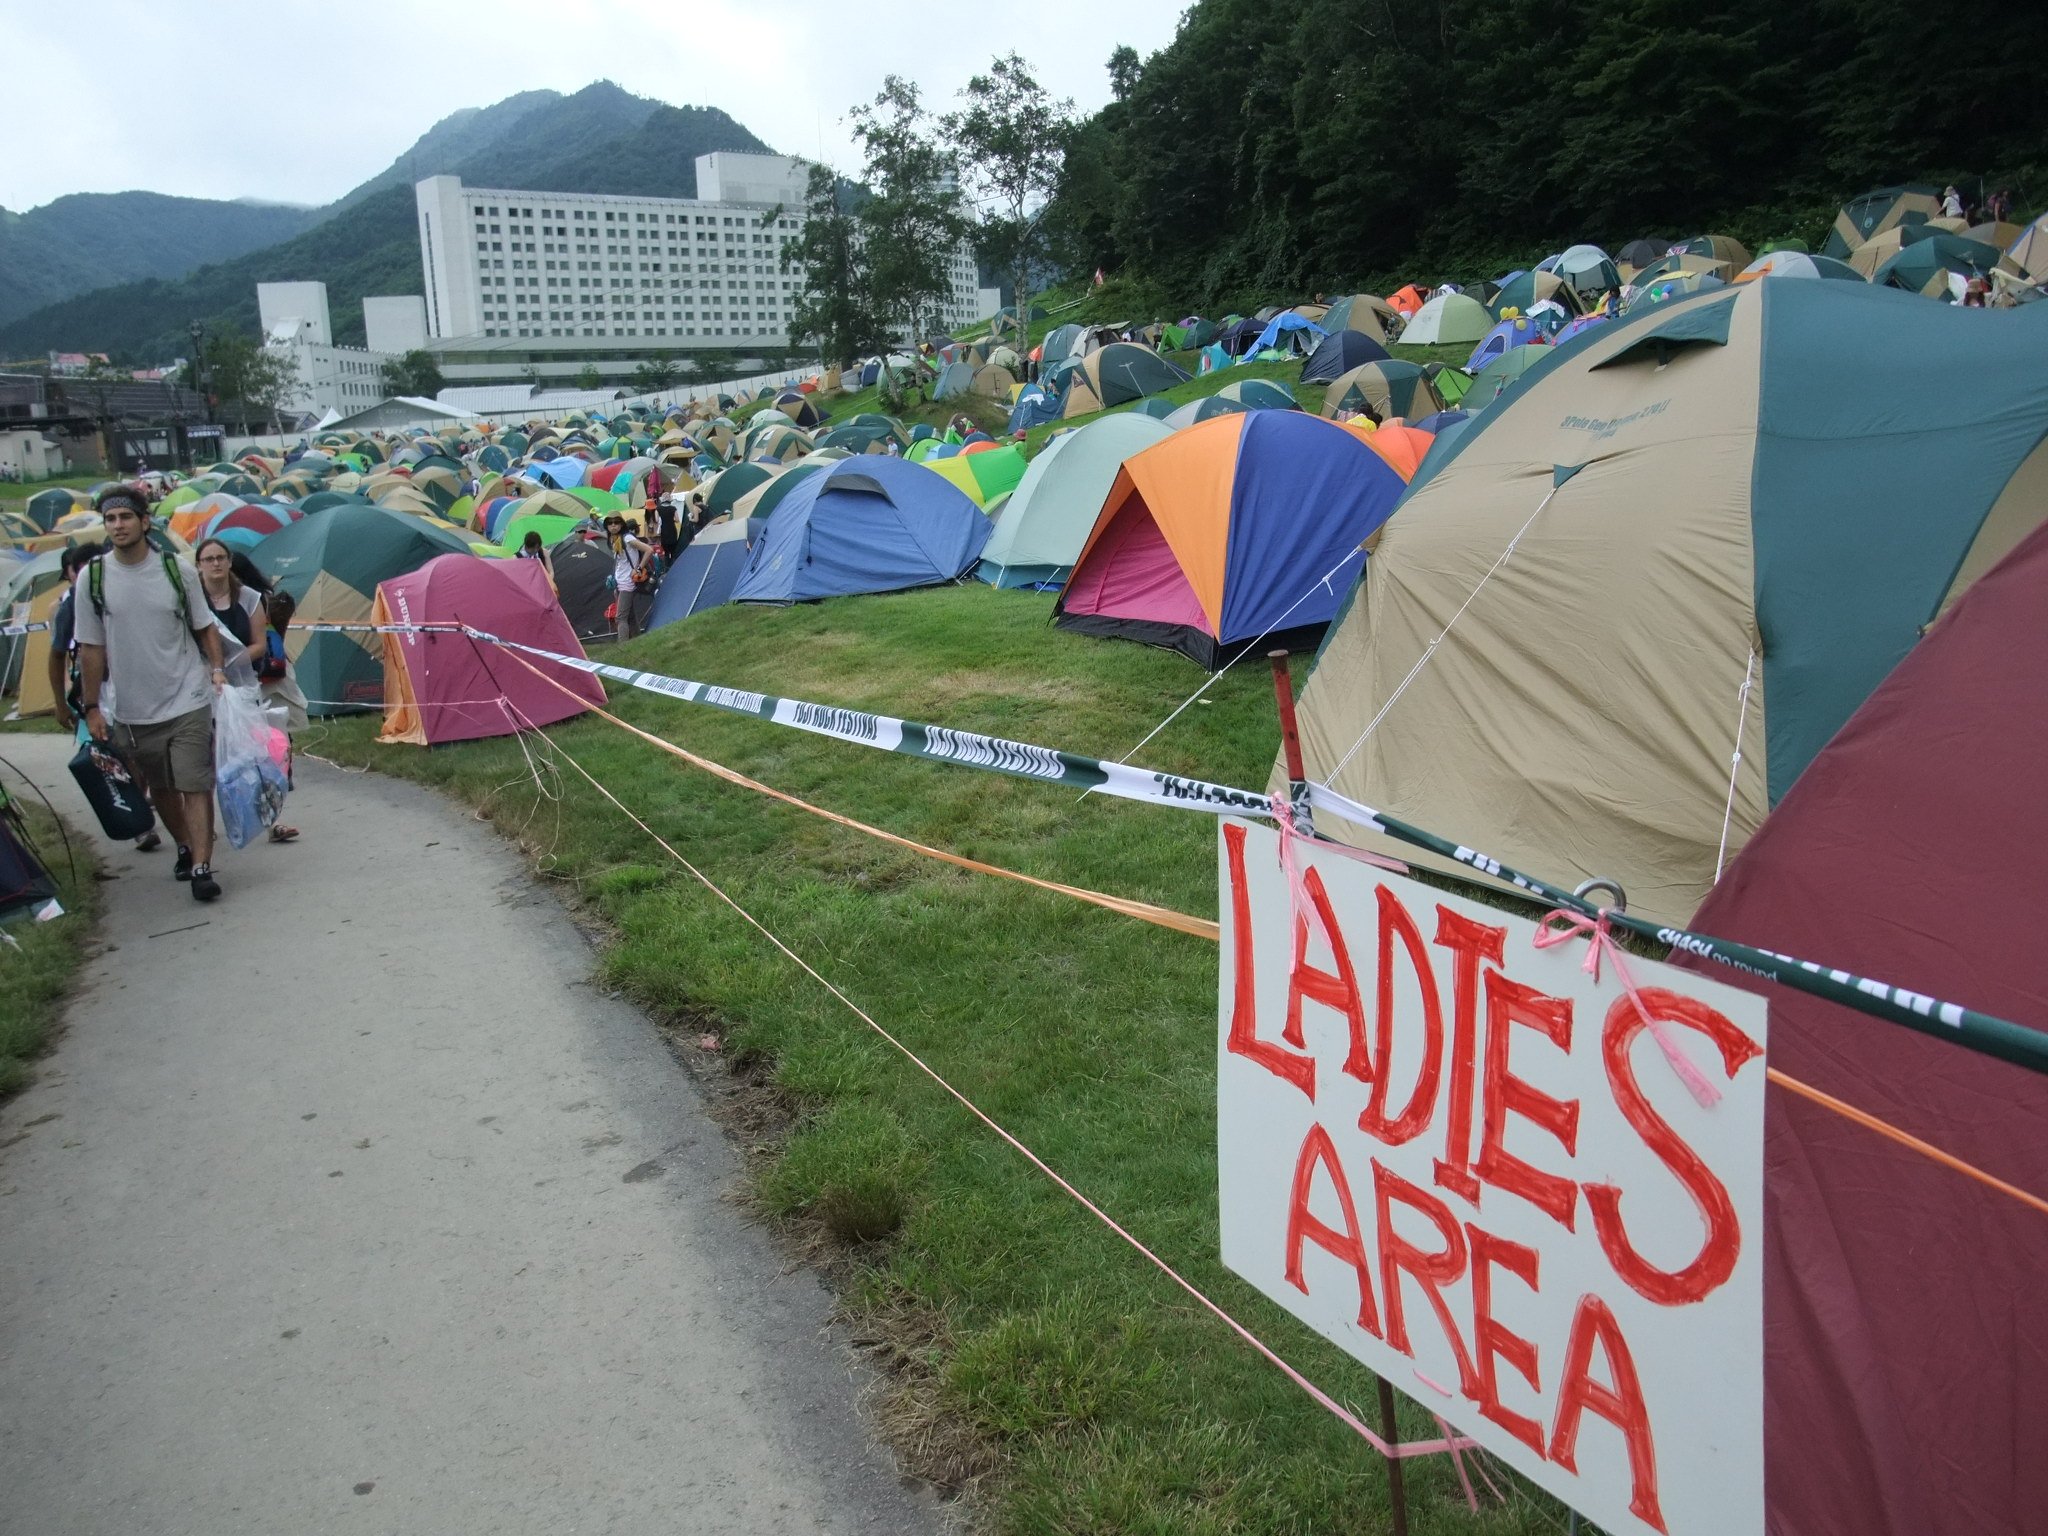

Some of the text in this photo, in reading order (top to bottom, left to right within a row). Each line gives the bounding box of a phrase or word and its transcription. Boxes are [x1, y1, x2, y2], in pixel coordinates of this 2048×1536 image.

[836, 710, 879, 740] FESTIVAL
[1222, 822, 1766, 1306] LADIES
[1285, 1121, 1669, 1535] AREA
